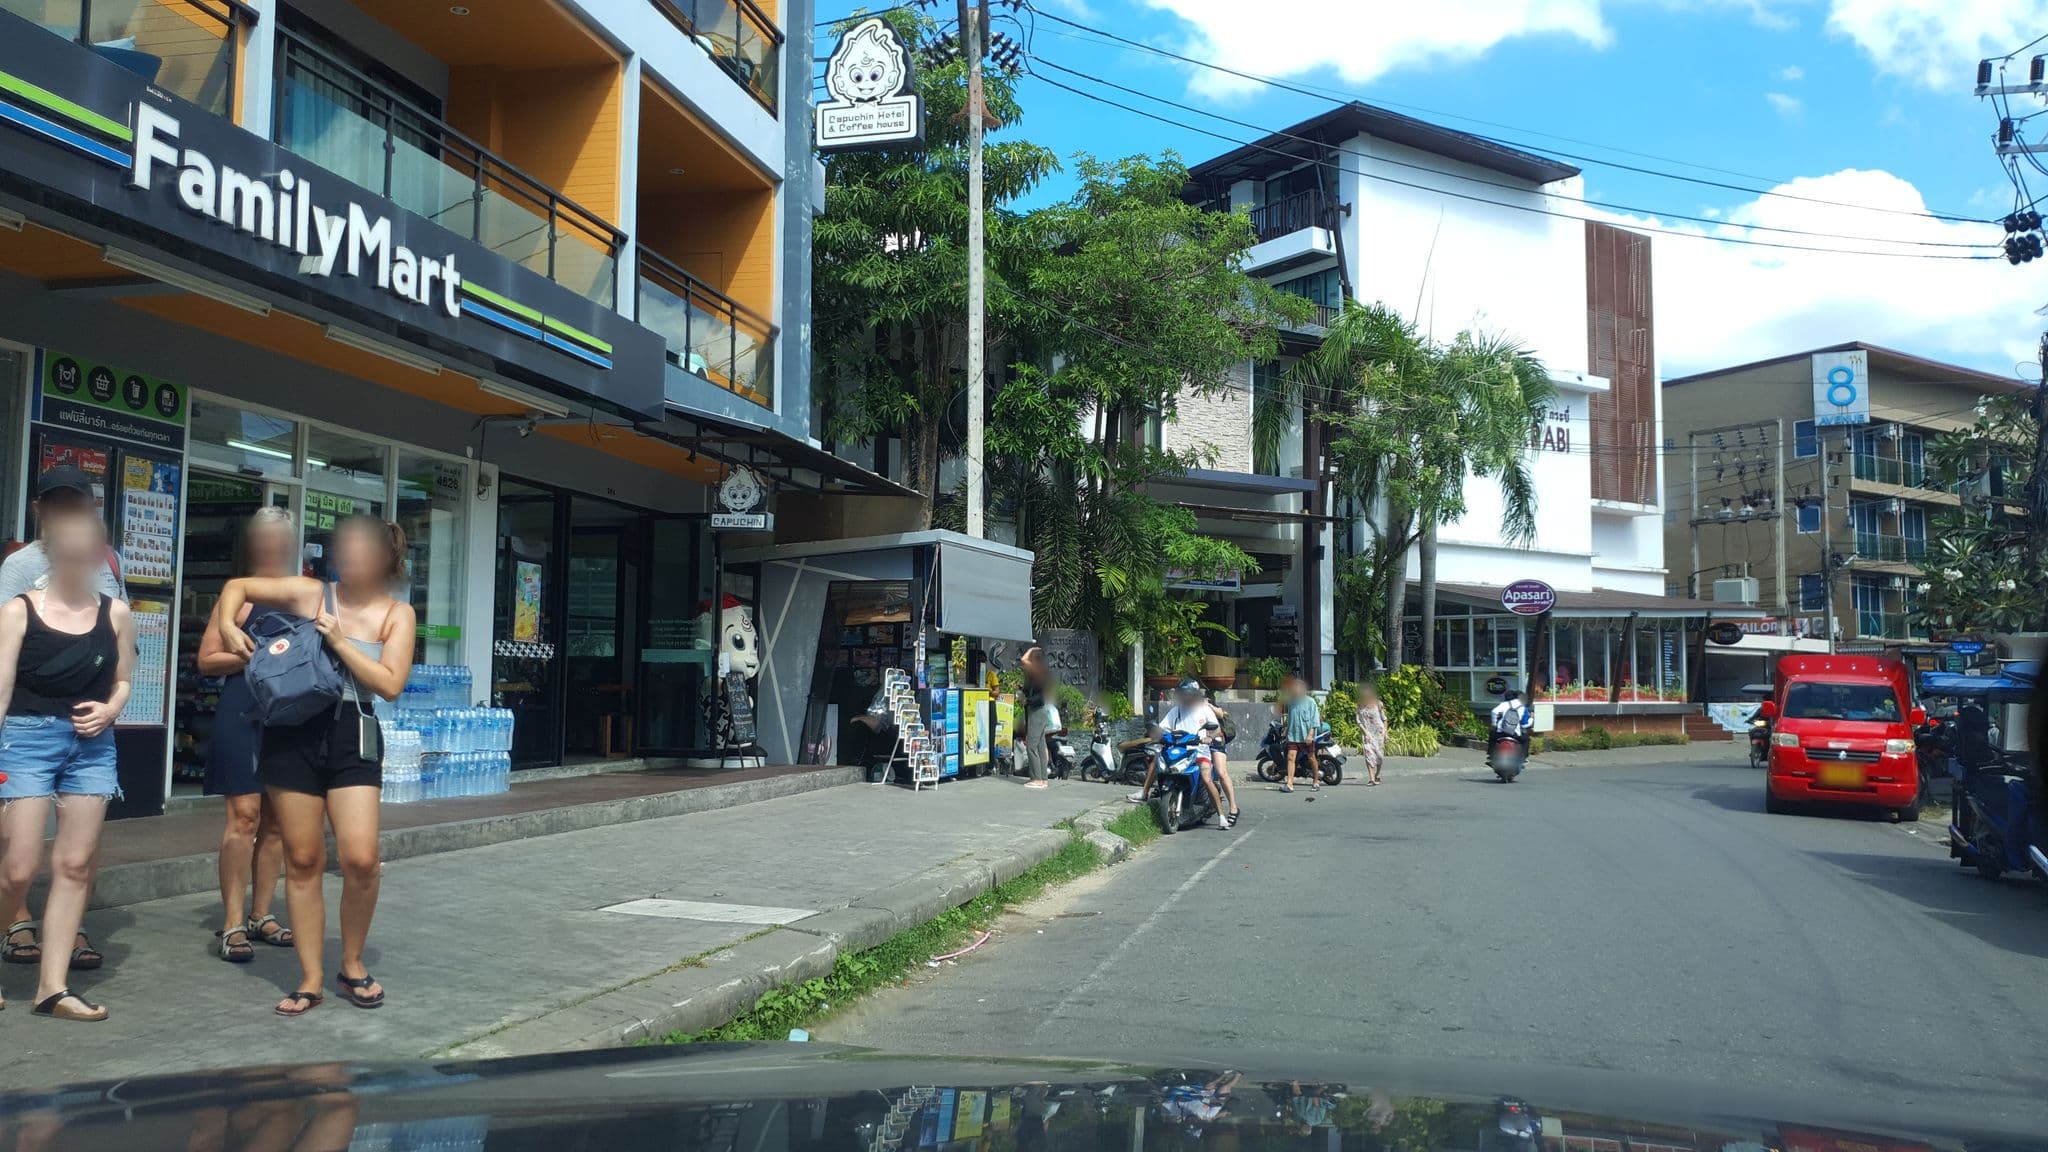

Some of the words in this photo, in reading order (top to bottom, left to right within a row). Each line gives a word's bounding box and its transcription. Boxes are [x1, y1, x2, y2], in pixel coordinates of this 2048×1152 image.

[829, 113, 874, 124] Capuchin
[878, 110, 905, 120] Hotel
[839, 122, 874, 132] Coffee
[876, 120, 905, 129] house
[132, 101, 463, 318] FamilyMart
[1827, 366, 1857, 407] 8
[1819, 414, 1865, 425] AVENUE
[713, 517, 763, 526] CAPUCHIN
[1505, 589, 1550, 602] Apasari
